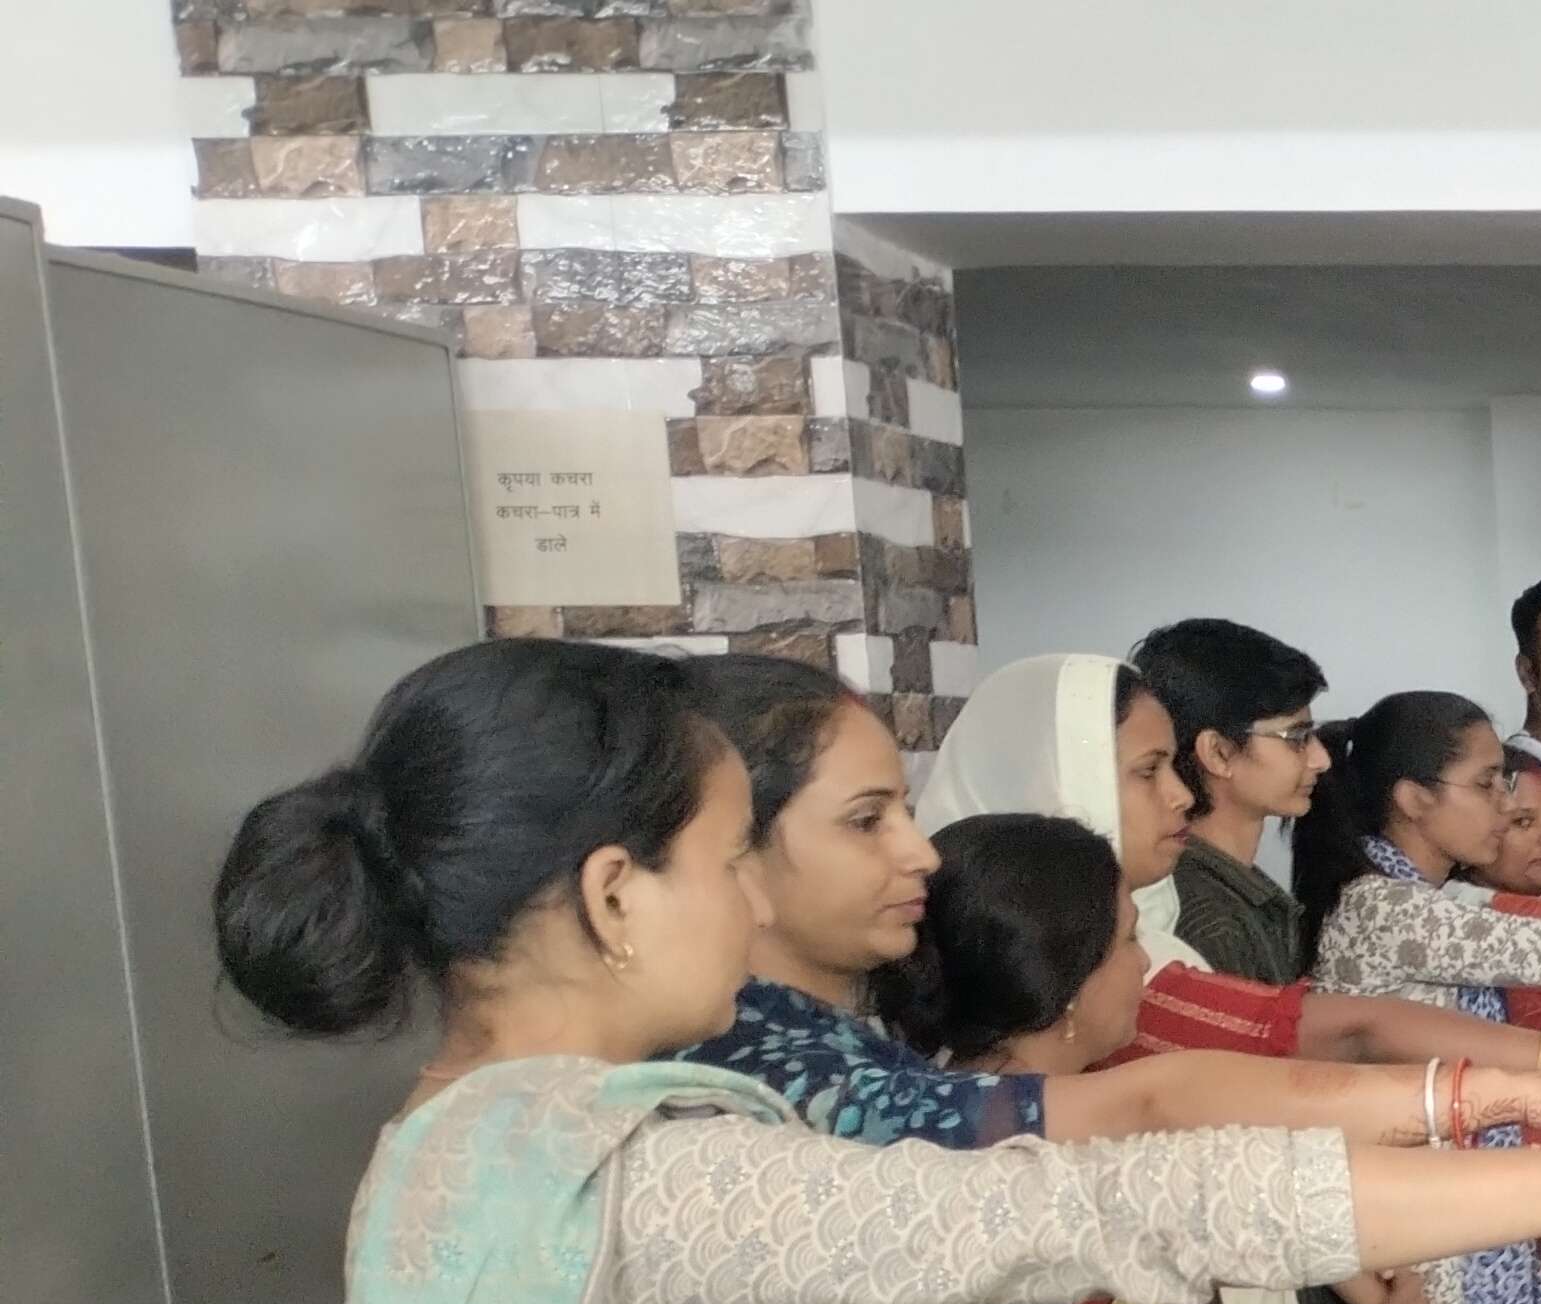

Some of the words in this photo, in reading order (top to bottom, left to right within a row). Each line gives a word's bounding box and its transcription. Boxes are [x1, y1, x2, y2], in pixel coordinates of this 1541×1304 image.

[497, 472, 541, 492] कृपया
[550, 472, 592, 486] कचरा
[590, 499, 601, 518] में
